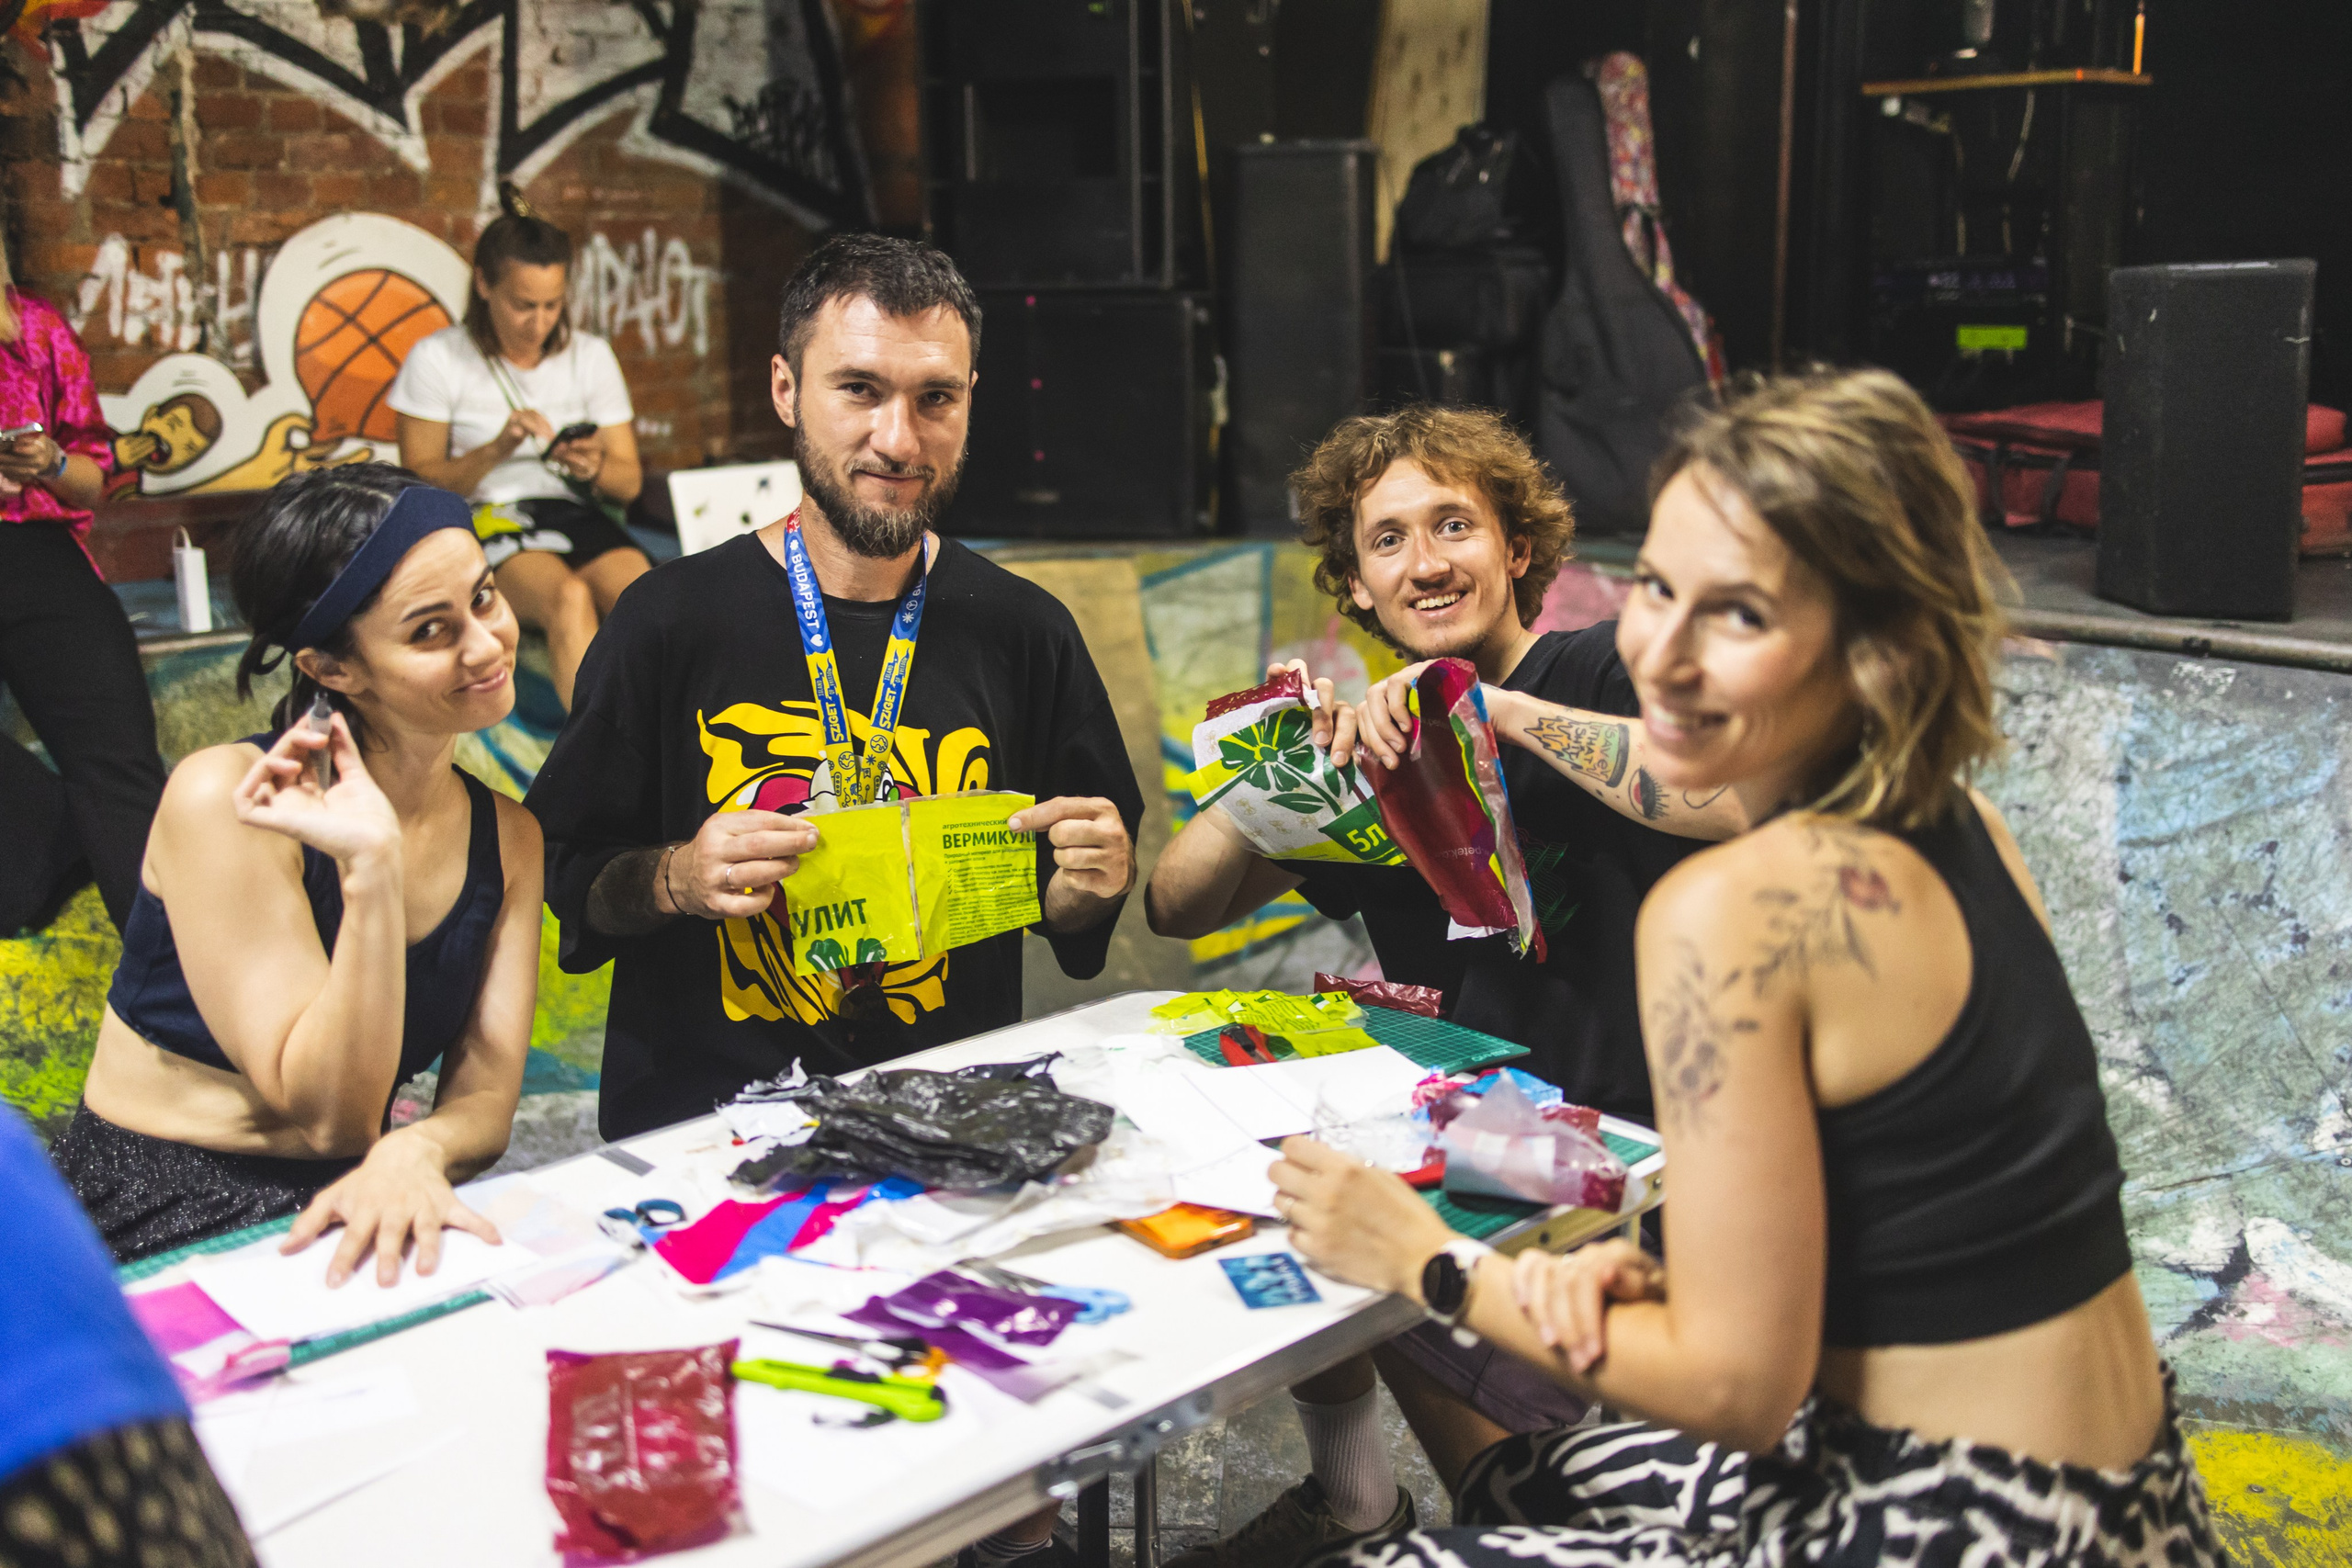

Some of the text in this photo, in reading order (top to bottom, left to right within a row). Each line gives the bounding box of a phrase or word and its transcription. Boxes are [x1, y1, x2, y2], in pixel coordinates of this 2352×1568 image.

[791, 553, 820, 629] BUDAPEST
[942, 818, 1009, 830] агротехнический
[791, 897, 866, 940] УЛИТ
